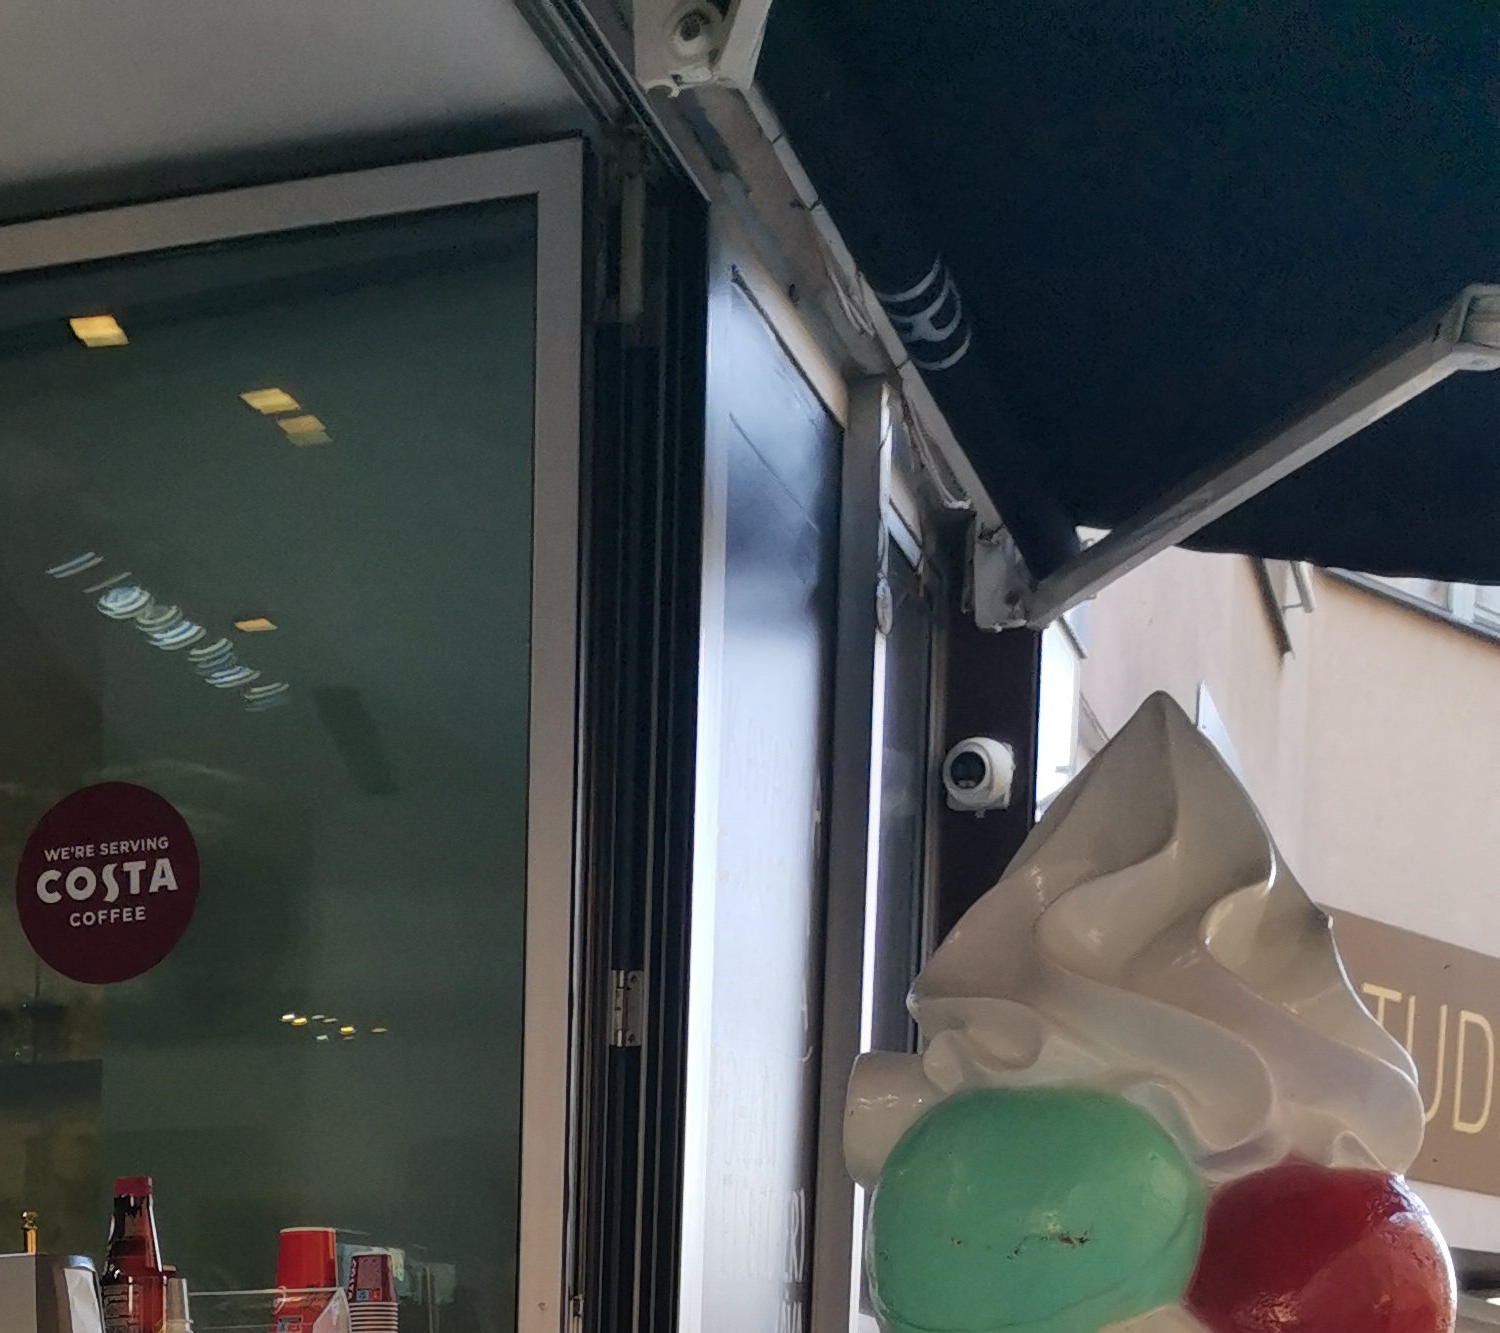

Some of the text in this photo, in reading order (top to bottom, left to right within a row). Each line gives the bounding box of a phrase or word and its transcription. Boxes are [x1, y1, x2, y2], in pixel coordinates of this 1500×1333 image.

[44, 836, 170, 861] WE'RE SERVING
[36, 857, 179, 903] COSTA
[69, 906, 147, 927] COFFEE
